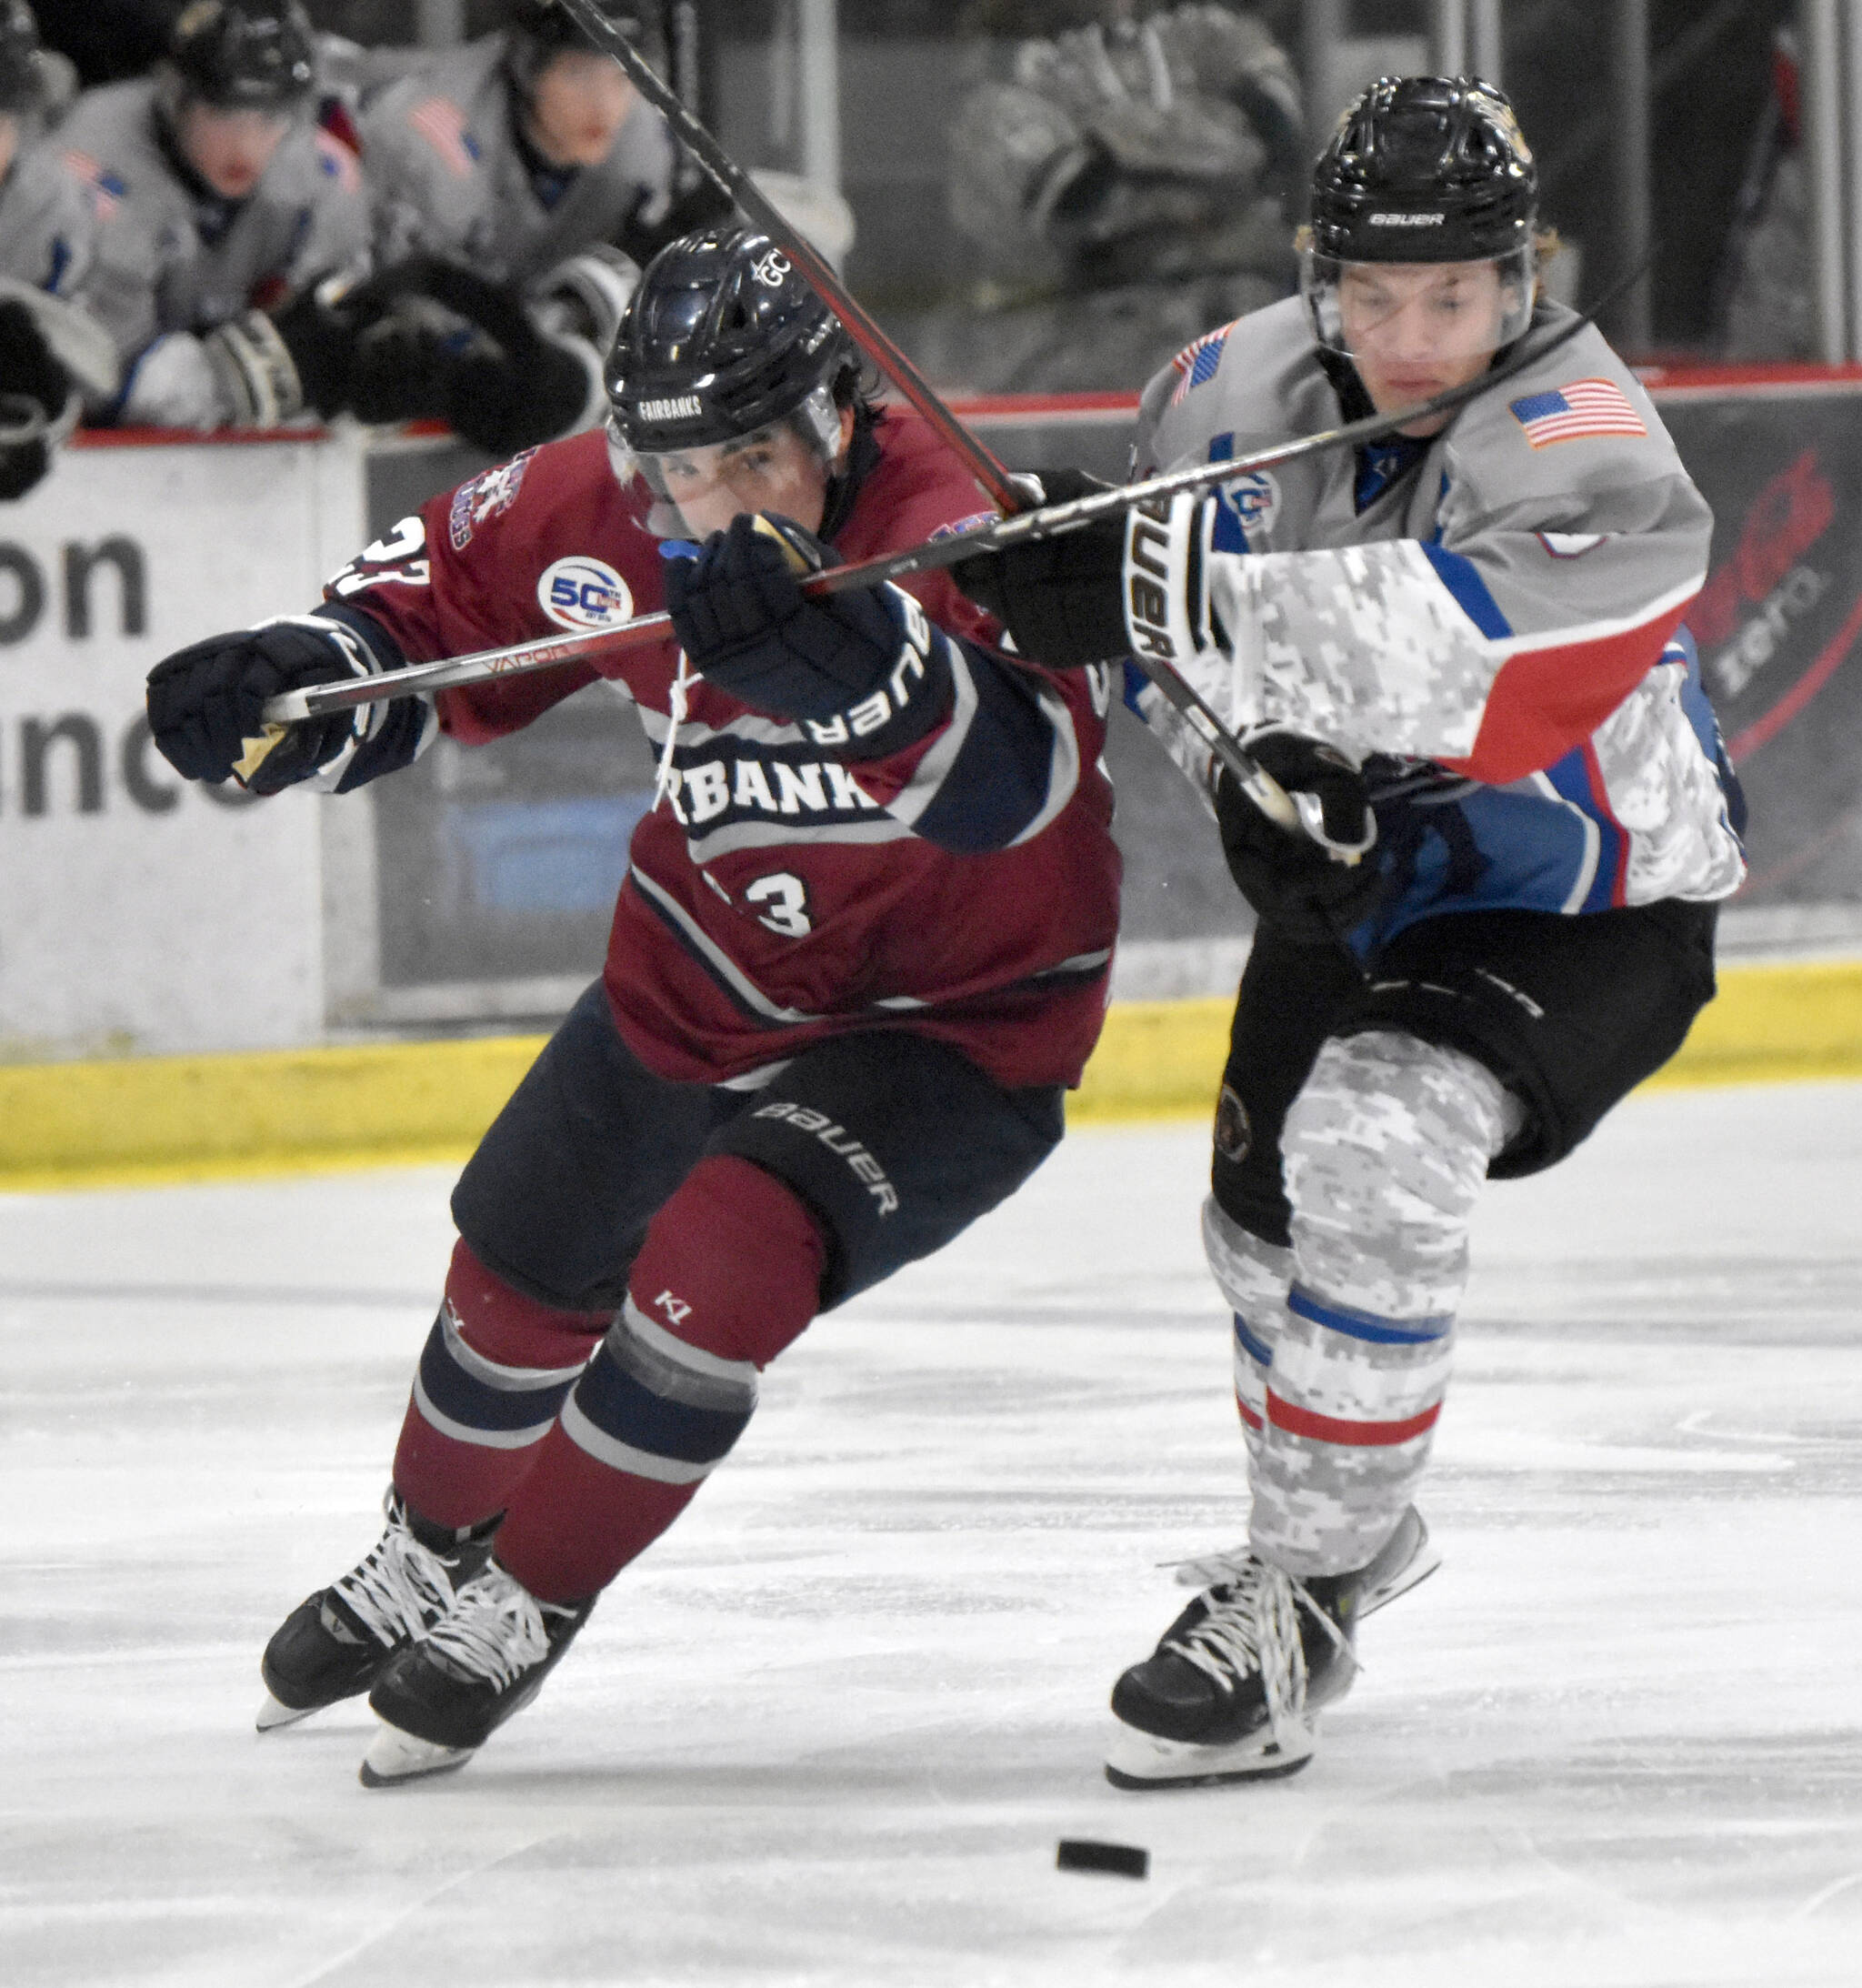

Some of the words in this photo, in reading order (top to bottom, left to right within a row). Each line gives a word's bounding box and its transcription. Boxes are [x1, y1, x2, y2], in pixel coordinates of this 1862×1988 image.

[1367, 213, 1446, 227] BAUER
[761, 247, 792, 288] GC
[638, 395, 703, 422] FAIRBANKS
[481, 644, 573, 673] VAPOR
[18, 708, 268, 816] nc
[753, 1102, 899, 1219] BAUER
[654, 1290, 693, 1326] K1
